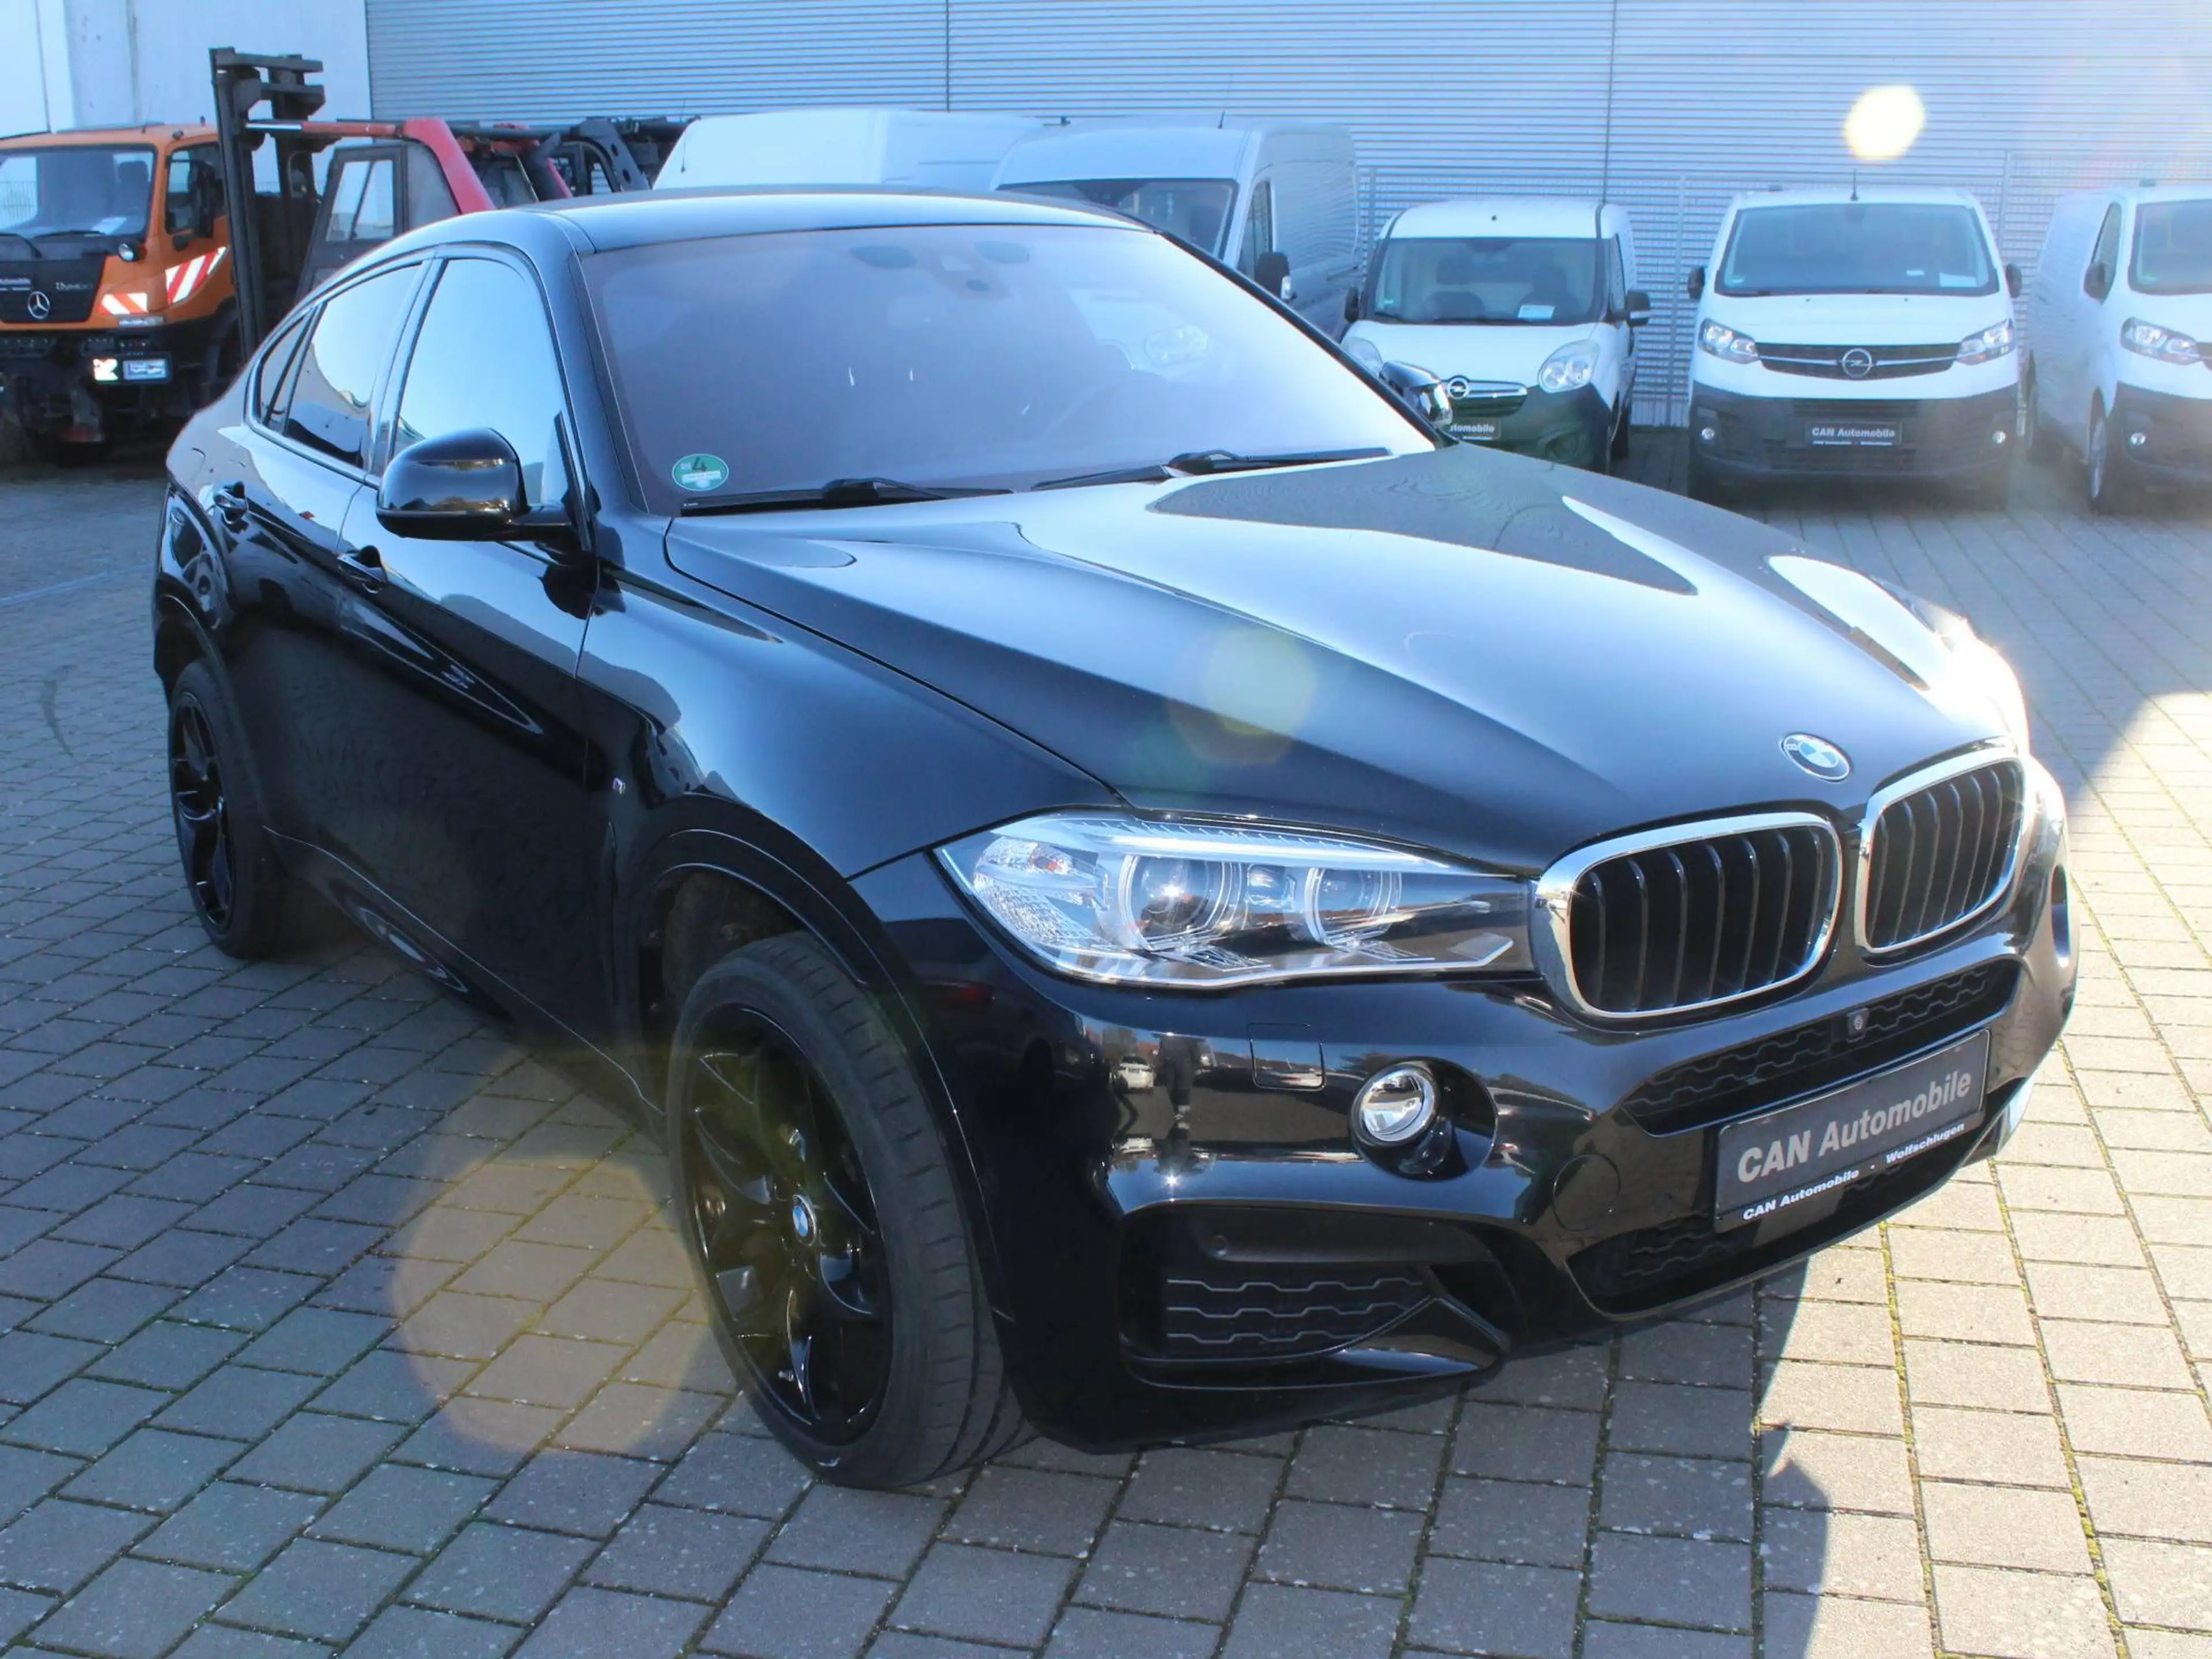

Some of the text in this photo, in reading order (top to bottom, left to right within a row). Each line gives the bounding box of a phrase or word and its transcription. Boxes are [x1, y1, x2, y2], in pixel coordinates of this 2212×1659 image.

[1450, 423, 1495, 433] tomobile
[1812, 427, 1895, 438] CAN Automobile
[1737, 1070, 1972, 1183] CAN Automobile
[1743, 1123, 1964, 1221] CAN Automobile Wolfschlugen
